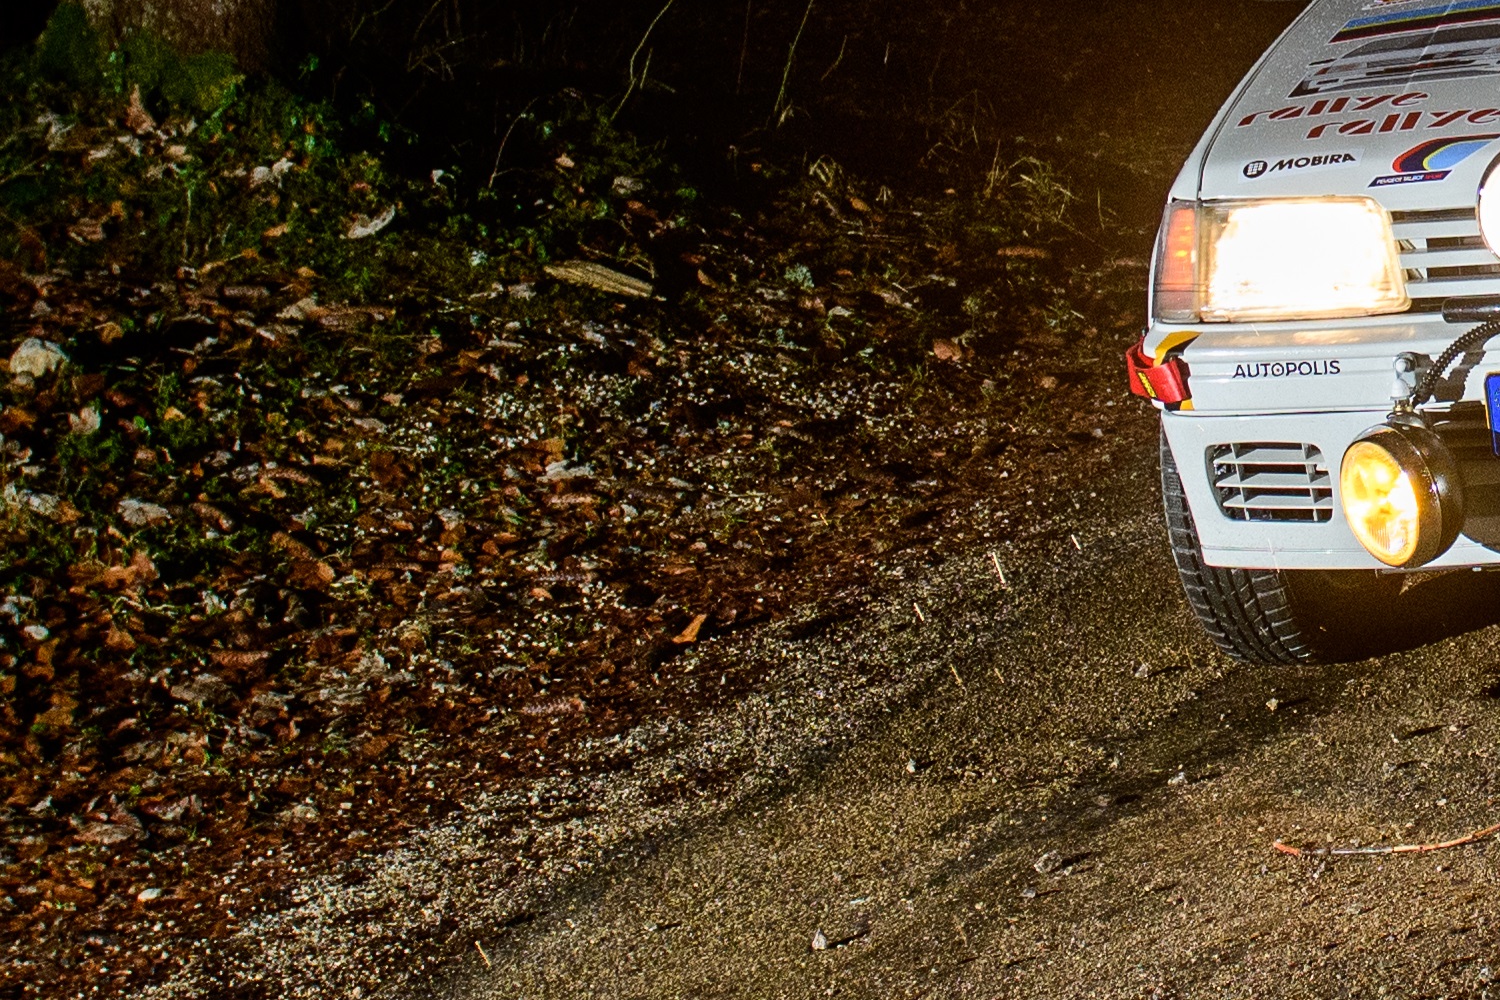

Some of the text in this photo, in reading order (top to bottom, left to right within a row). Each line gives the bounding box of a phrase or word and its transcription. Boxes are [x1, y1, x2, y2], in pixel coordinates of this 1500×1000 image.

[1237, 92, 1429, 127] rallye
[1269, 152, 1357, 173] MOBIRA
[1232, 360, 1342, 379] AUTOPOLIS
